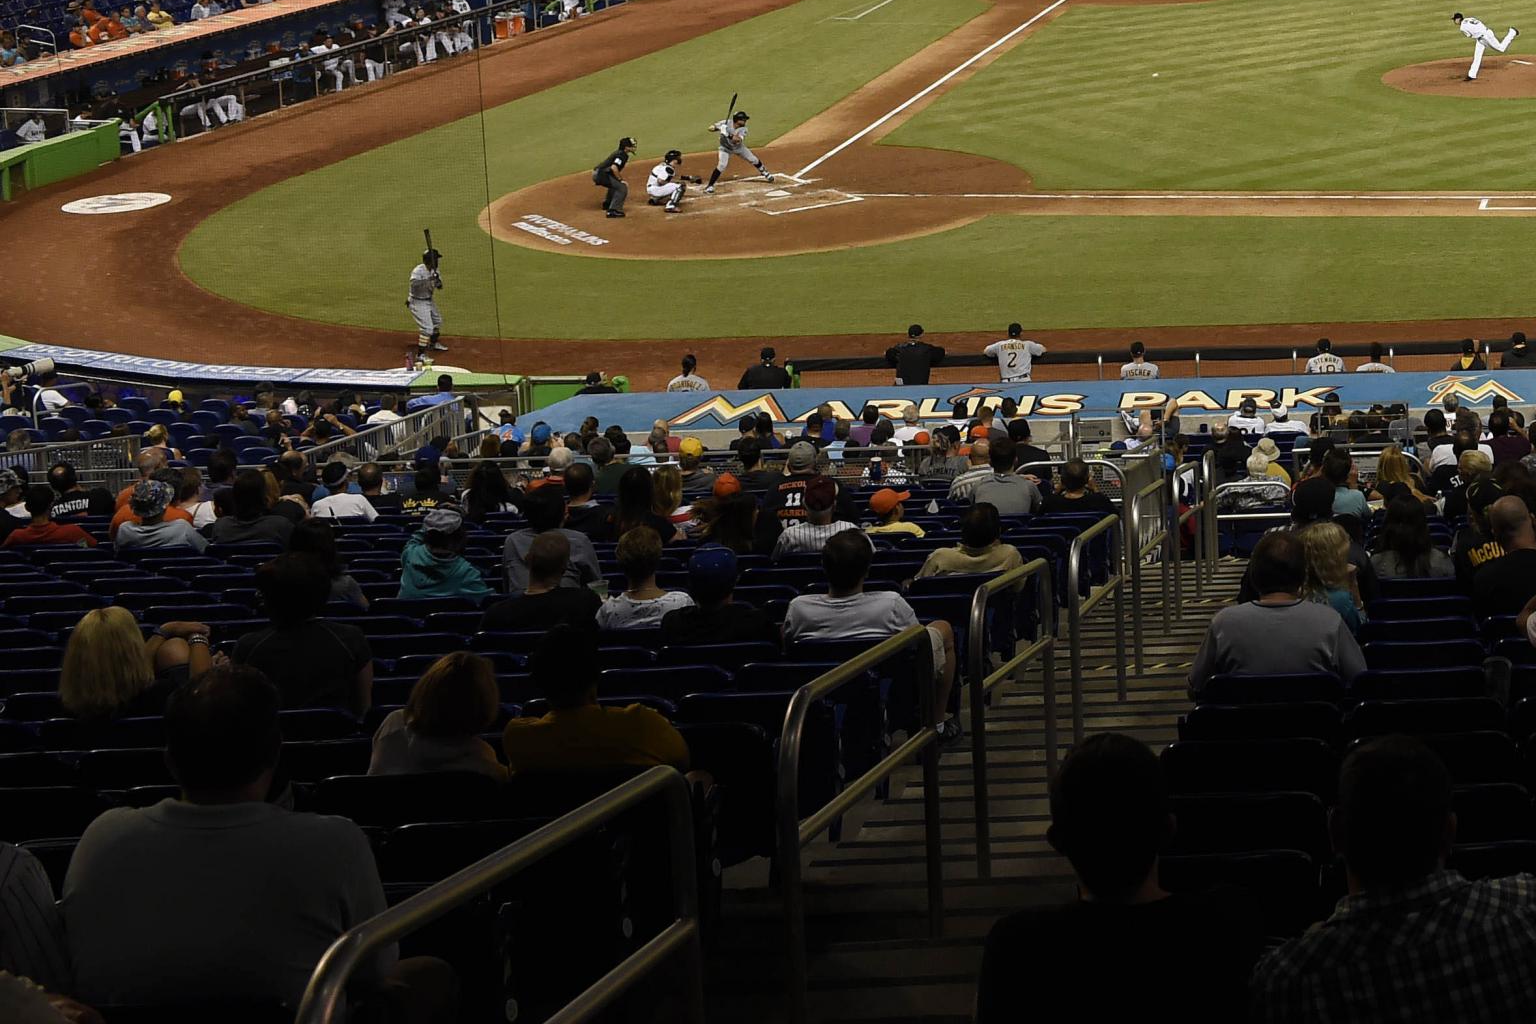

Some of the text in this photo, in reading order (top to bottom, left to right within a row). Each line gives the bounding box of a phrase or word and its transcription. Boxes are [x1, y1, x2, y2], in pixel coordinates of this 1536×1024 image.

[1007, 352, 1017, 367] 2
[1314, 357, 1340, 365] STEWART
[666, 384, 1345, 427] MARLINS PARK
[785, 492, 801, 507] 11
[51, 498, 89, 518] STANTON
